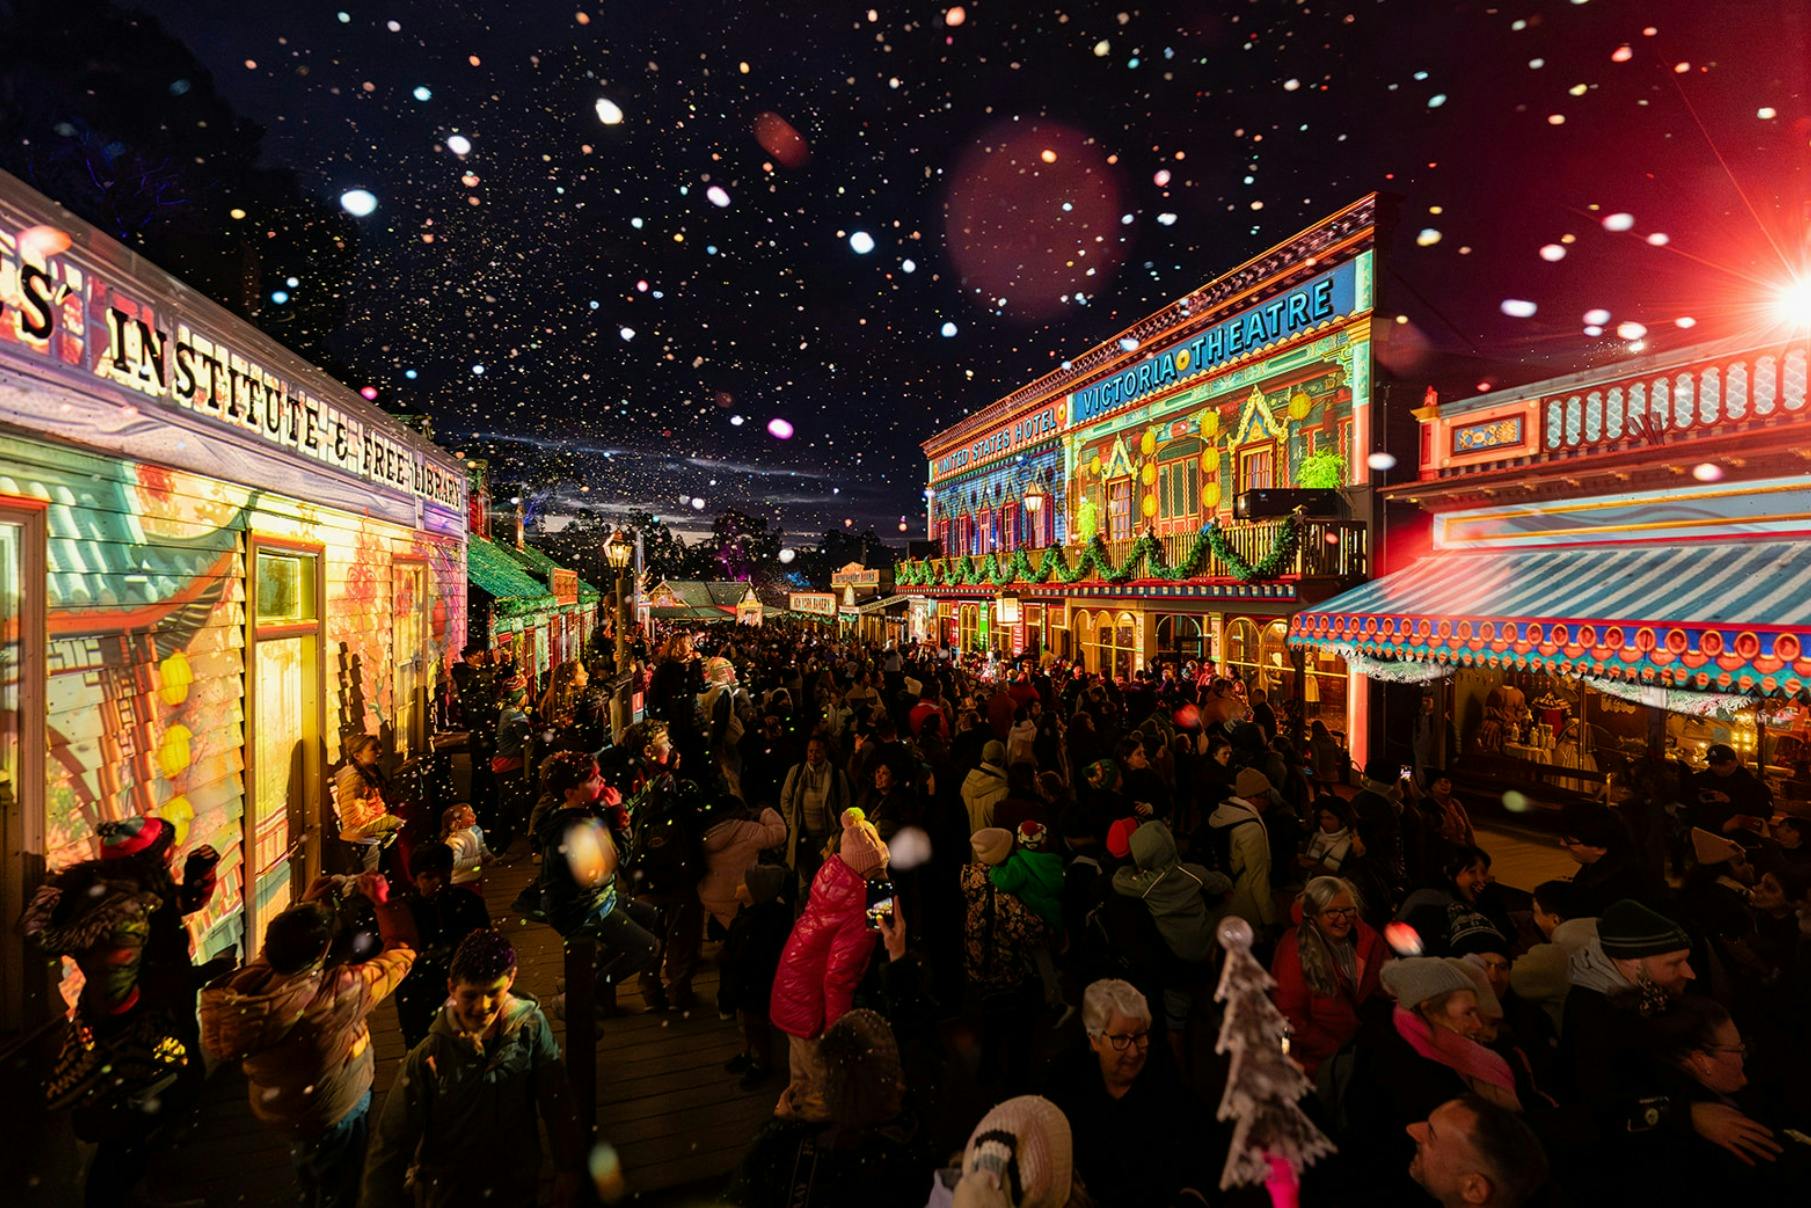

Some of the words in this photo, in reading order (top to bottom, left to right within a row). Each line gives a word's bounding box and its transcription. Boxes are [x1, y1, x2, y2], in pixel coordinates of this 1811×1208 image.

[0, 264, 72, 339] S'
[111, 306, 318, 450] INSTITUTE
[335, 422, 348, 461] &
[362, 435, 405, 486] FREE
[414, 462, 460, 508] LIBRARY
[1083, 352, 1177, 416] VICTORIA
[1192, 278, 1334, 368] THEATRE
[938, 447, 969, 475] UNITED
[972, 428, 1011, 461] STATES
[1015, 407, 1057, 439] HOTEL
